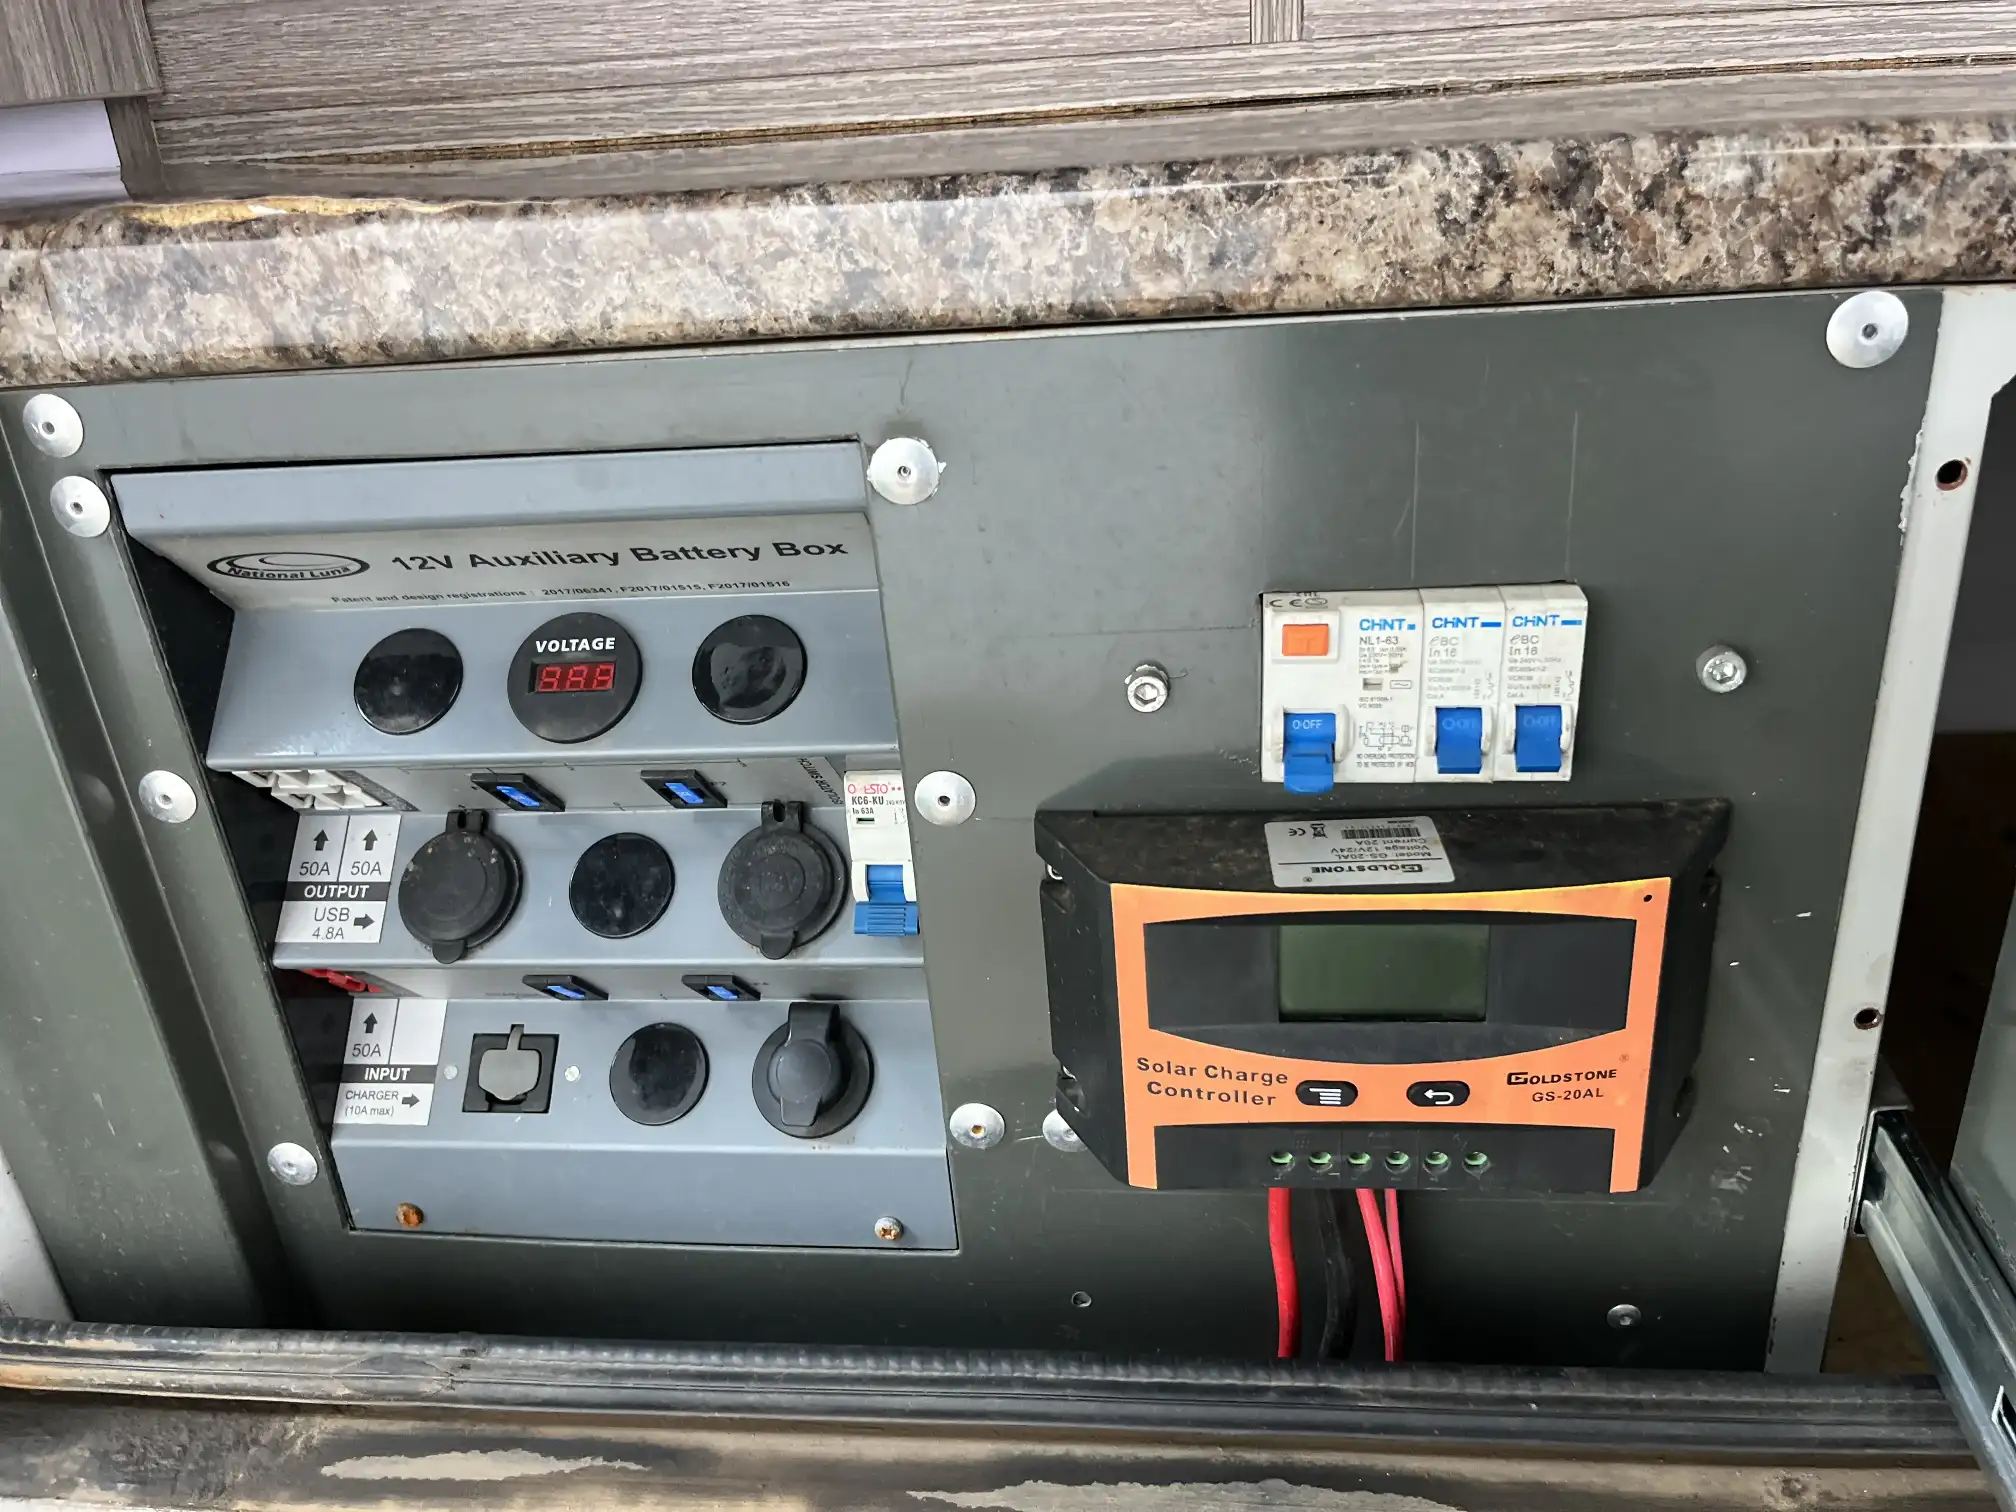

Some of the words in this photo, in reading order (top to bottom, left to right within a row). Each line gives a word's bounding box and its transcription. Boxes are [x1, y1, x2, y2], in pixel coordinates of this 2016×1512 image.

[391, 555, 454, 571] 12V
[470, 549, 620, 568] Auxiliary
[629, 546, 761, 562] Battery
[771, 542, 849, 557] Box
[227, 566, 305, 580] National
[310, 565, 351, 579] Luna
[402, 593, 444, 602] design
[446, 590, 526, 599] registrations
[535, 637, 616, 653] VOLTAGE
[1359, 636, 1399, 646] NL1-63
[1428, 647, 1441, 657] In
[1509, 646, 1521, 656] In
[797, 756, 824, 779] SWITCH
[814, 778, 844, 805] SOLATOR
[847, 783, 889, 795] OESTO
[851, 796, 884, 806] KC6-KU
[860, 807, 874, 815] 63A
[299, 861, 330, 876] 50A
[350, 860, 382, 876] 50A
[1311, 863, 1423, 874] GOLDSTONE
[304, 884, 369, 899] OUTPUT
[314, 907, 350, 922] USB
[312, 926, 345, 940] 4.8A
[352, 1043, 381, 1057] 50A
[364, 1067, 411, 1081] INPUT
[1136, 1057, 1197, 1077] Solar
[1204, 1064, 1288, 1086] Charge
[1507, 1069, 1617, 1086] GOLDSTONE
[345, 1090, 399, 1101] CHARGER
[1147, 1081, 1276, 1106] Controller
[1532, 1087, 1604, 1103] GS-20AL
[344, 1105, 368, 1117] (10A
[370, 1106, 394, 1117] max)
